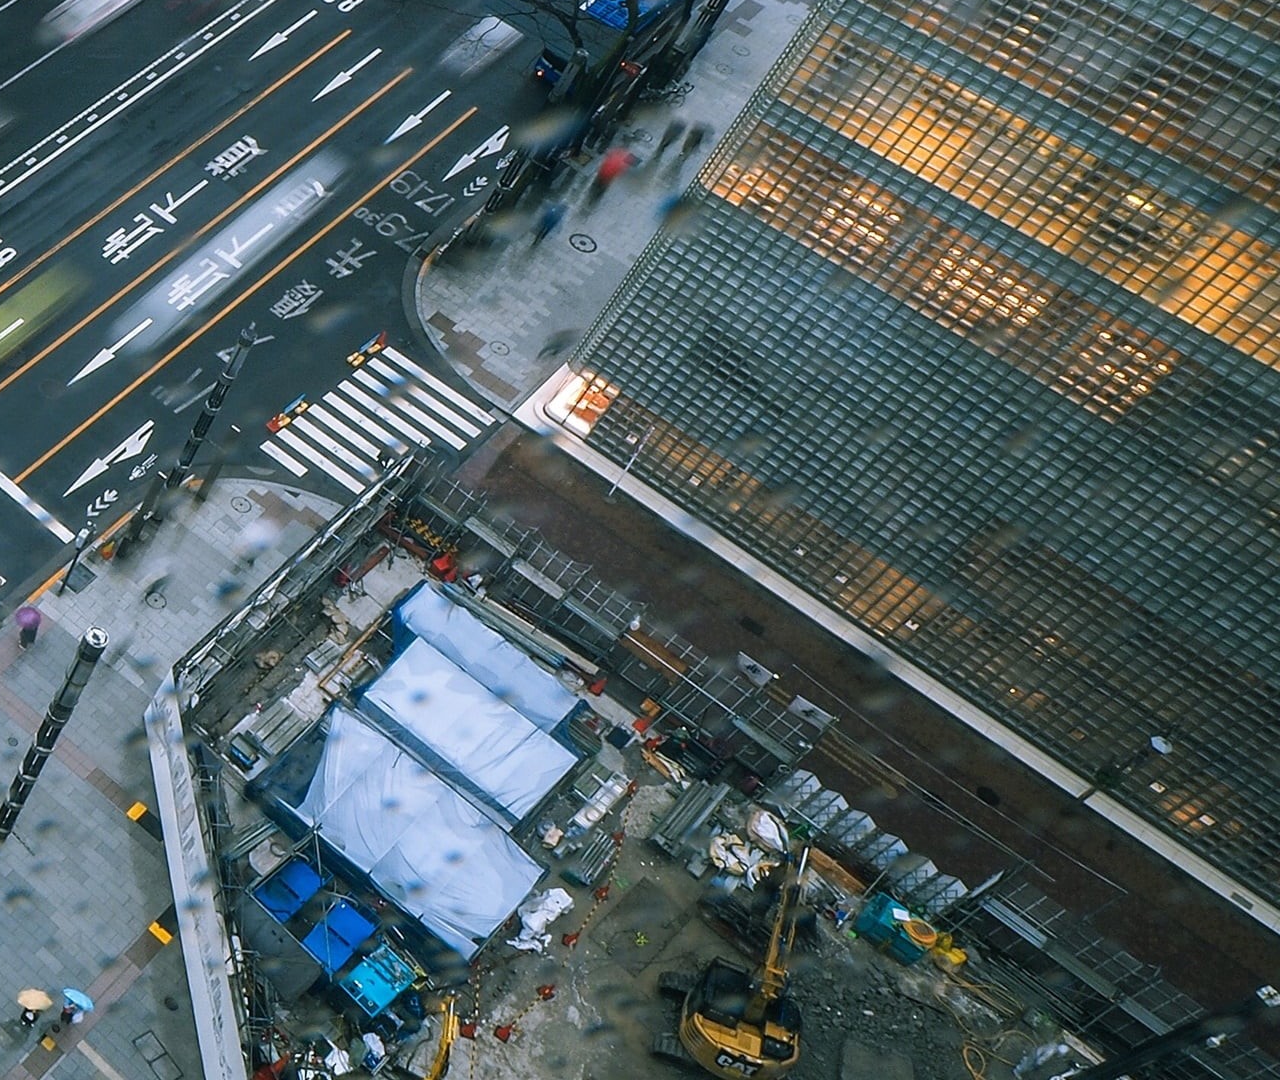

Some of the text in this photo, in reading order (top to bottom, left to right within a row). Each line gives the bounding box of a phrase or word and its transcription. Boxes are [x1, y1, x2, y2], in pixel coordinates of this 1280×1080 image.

[101, 134, 269, 265] 地下道
[388, 169, 456, 218] 17-19
[716, 1053, 759, 1078] CAT
